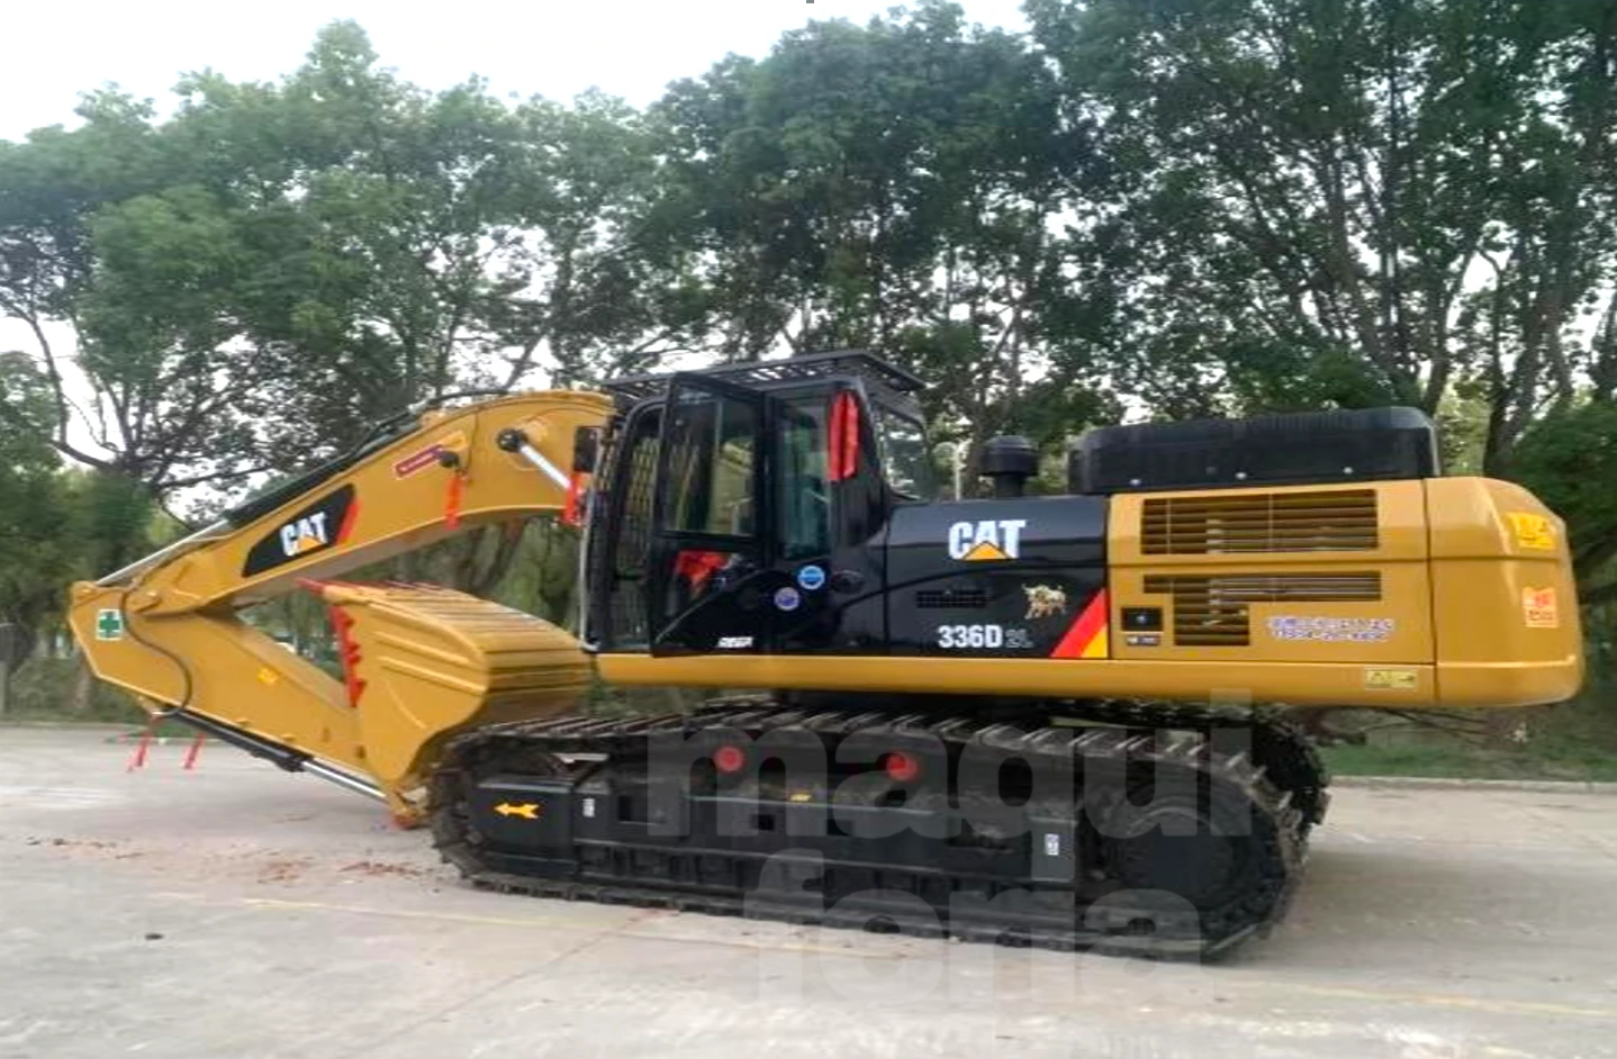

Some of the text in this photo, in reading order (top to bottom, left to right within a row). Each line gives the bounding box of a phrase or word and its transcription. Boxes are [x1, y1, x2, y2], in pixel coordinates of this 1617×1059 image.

[280, 511, 328, 557] CAT
[949, 519, 1027, 561] CAT
[938, 624, 1003, 648] 336D
